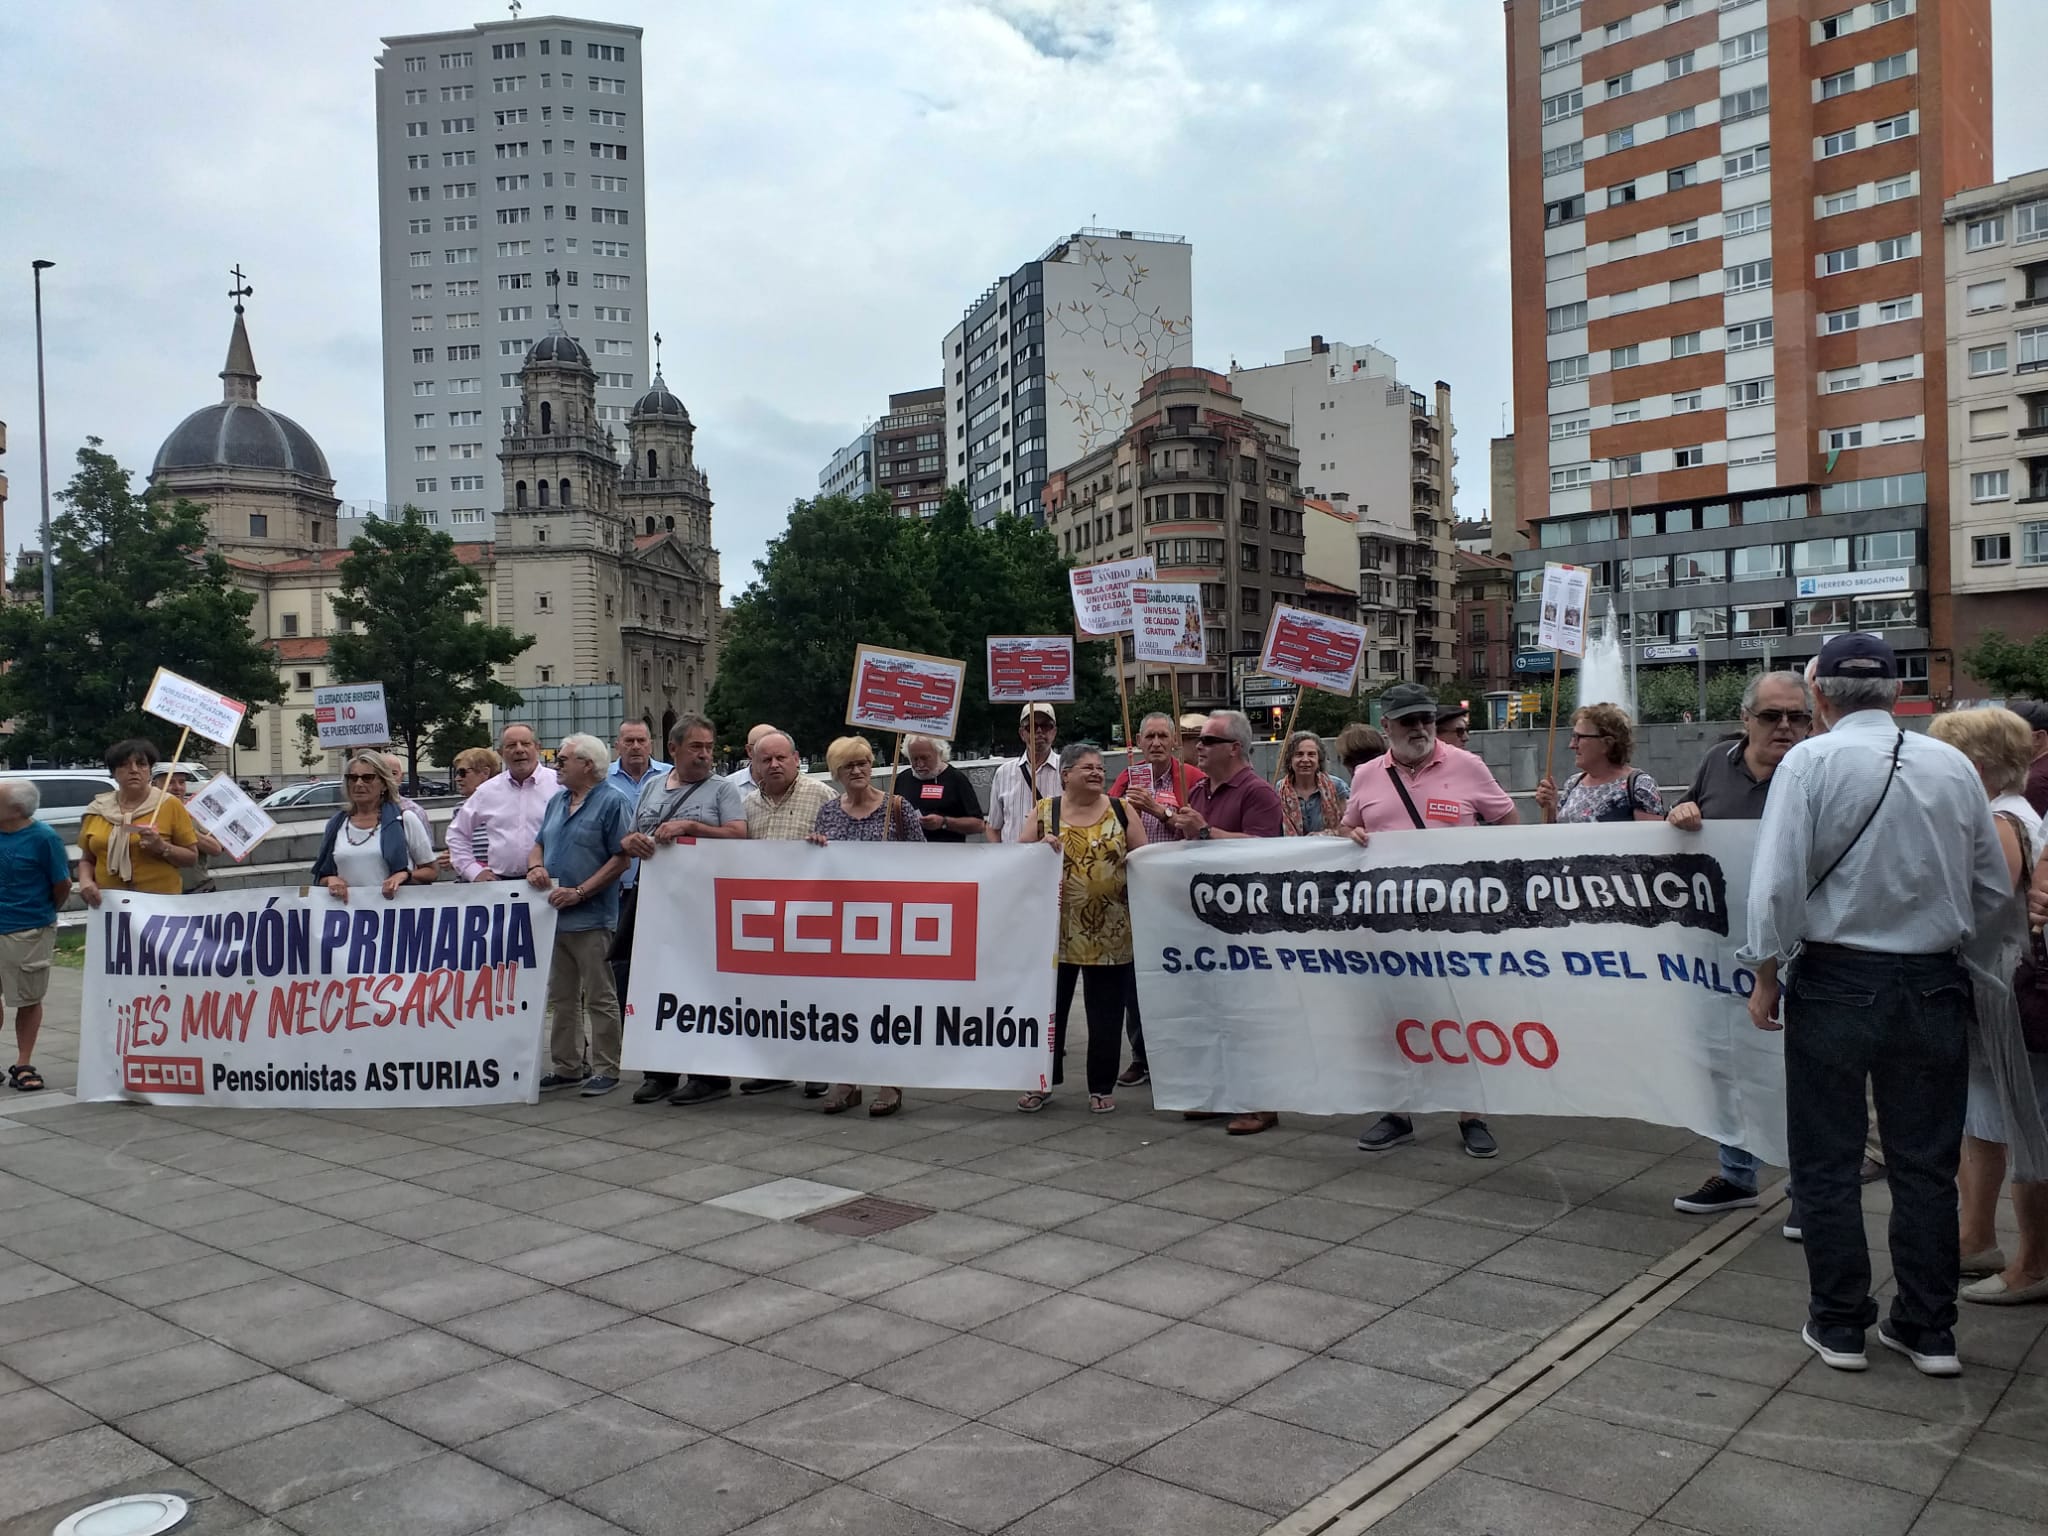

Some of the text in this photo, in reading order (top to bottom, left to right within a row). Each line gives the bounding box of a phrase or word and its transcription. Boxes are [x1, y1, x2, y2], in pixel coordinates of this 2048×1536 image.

[1818, 575, 1905, 590] HERRERO BRIGANTINA
[1086, 590, 1127, 604] UNIVERSAL
[1147, 594, 1171, 603] SANIDAD
[1091, 604, 1102, 613] DE
[1143, 606, 1181, 615] UNIVERSAL
[1144, 616, 1180, 626] DE CALIDAD
[318, 690, 380, 705] EL ESTADO DE BIENESTAR
[341, 706, 356, 720] NO
[321, 726, 330, 737] SE
[349, 722, 385, 736] RECORTAR
[1430, 802, 1459, 813] CCOO
[1193, 865, 1715, 916] POR LA SANIDAD PÚBLICA
[731, 899, 953, 956] CCOO
[105, 897, 537, 978] LA ATENCIÓN PRIMARIA
[1275, 947, 1550, 978] PENSIONISTAS
[1561, 951, 1648, 979] DEL
[1658, 952, 1786, 998] NALO
[116, 961, 518, 1056] ¡¡ES MUY NECESARIA!!
[655, 992, 859, 1044] Pensionistas
[870, 1004, 922, 1046] del
[936, 1005, 1040, 1048] Nalón
[1395, 1018, 1560, 1069] CCOO
[127, 1058, 500, 1092] CCOO Pensionistas ASTURIAS
